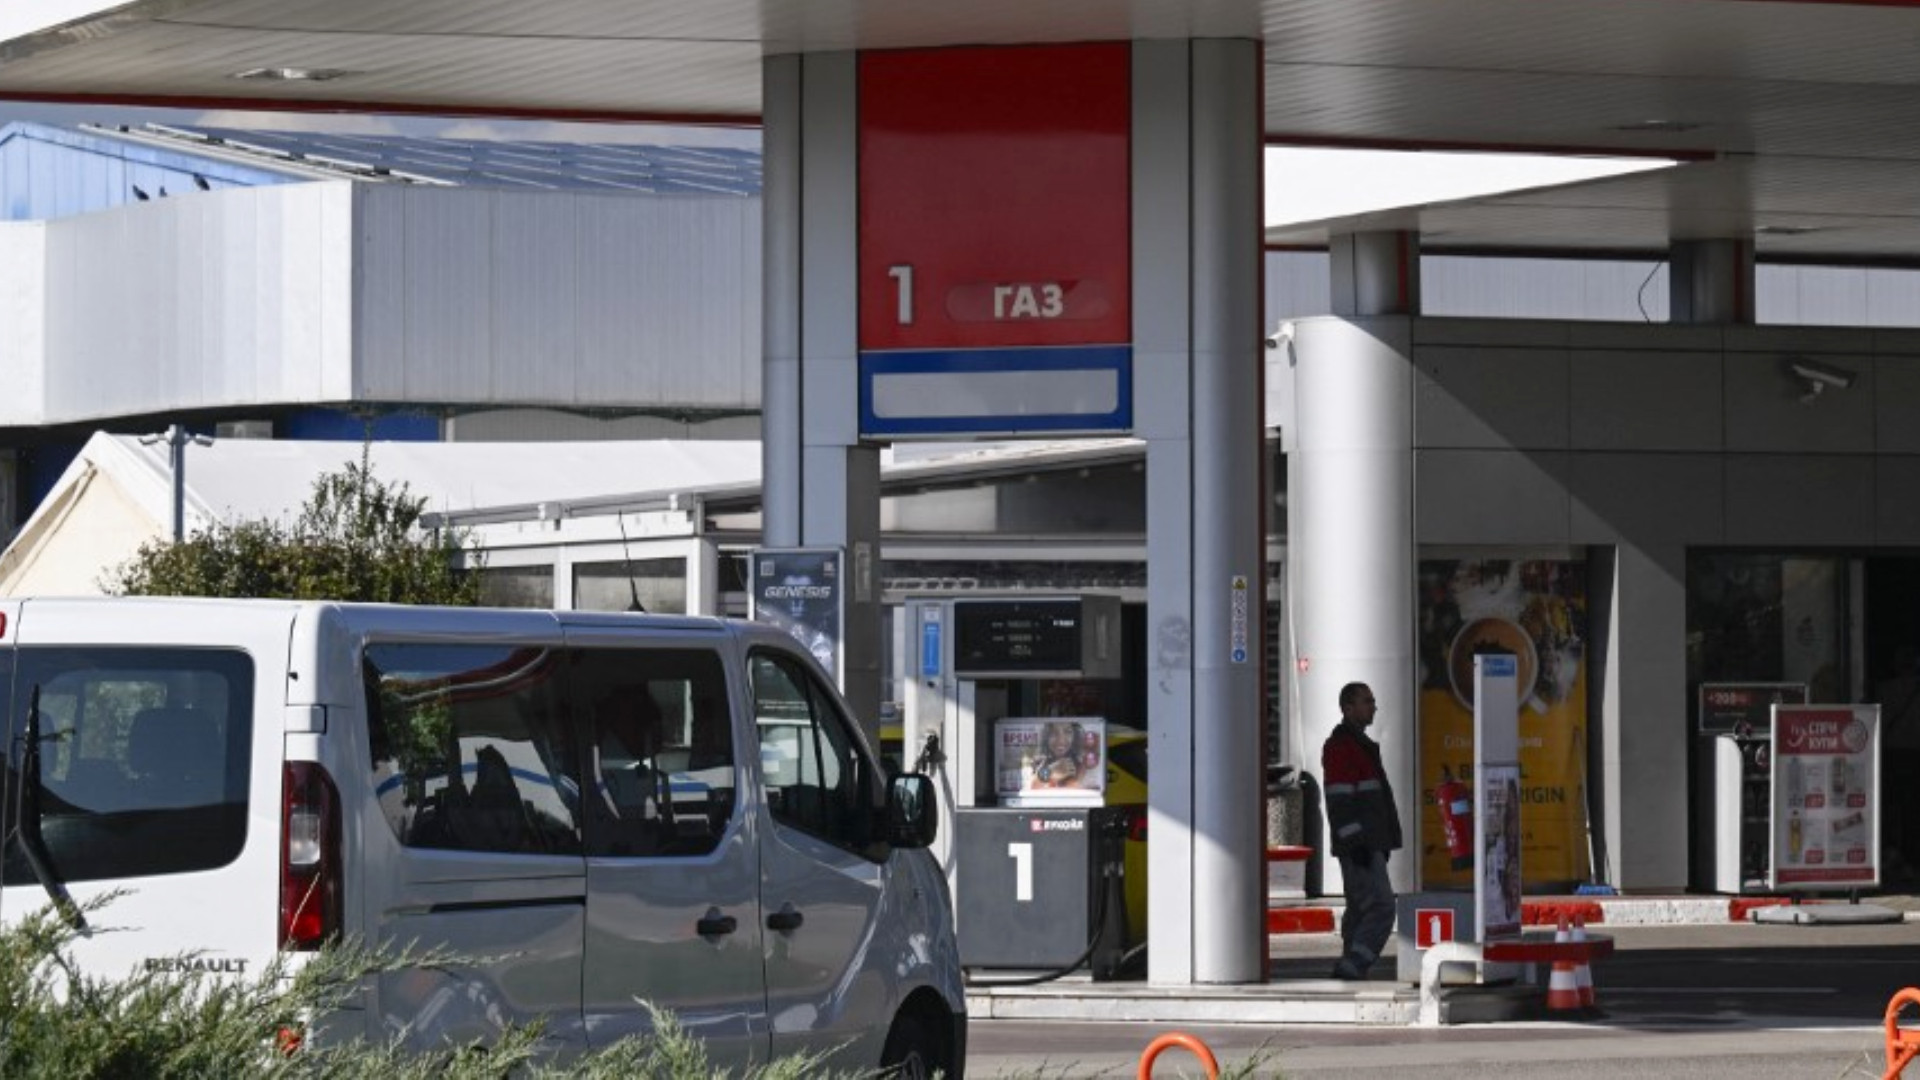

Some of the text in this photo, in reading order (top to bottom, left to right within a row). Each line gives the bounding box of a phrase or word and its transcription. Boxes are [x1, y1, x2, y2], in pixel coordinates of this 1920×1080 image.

[888, 265, 1064, 325] 1 ГАЗ
[764, 586, 832, 598] GENESIS
[1007, 843, 1033, 901] 1
[144, 958, 249, 973] RENAULT
